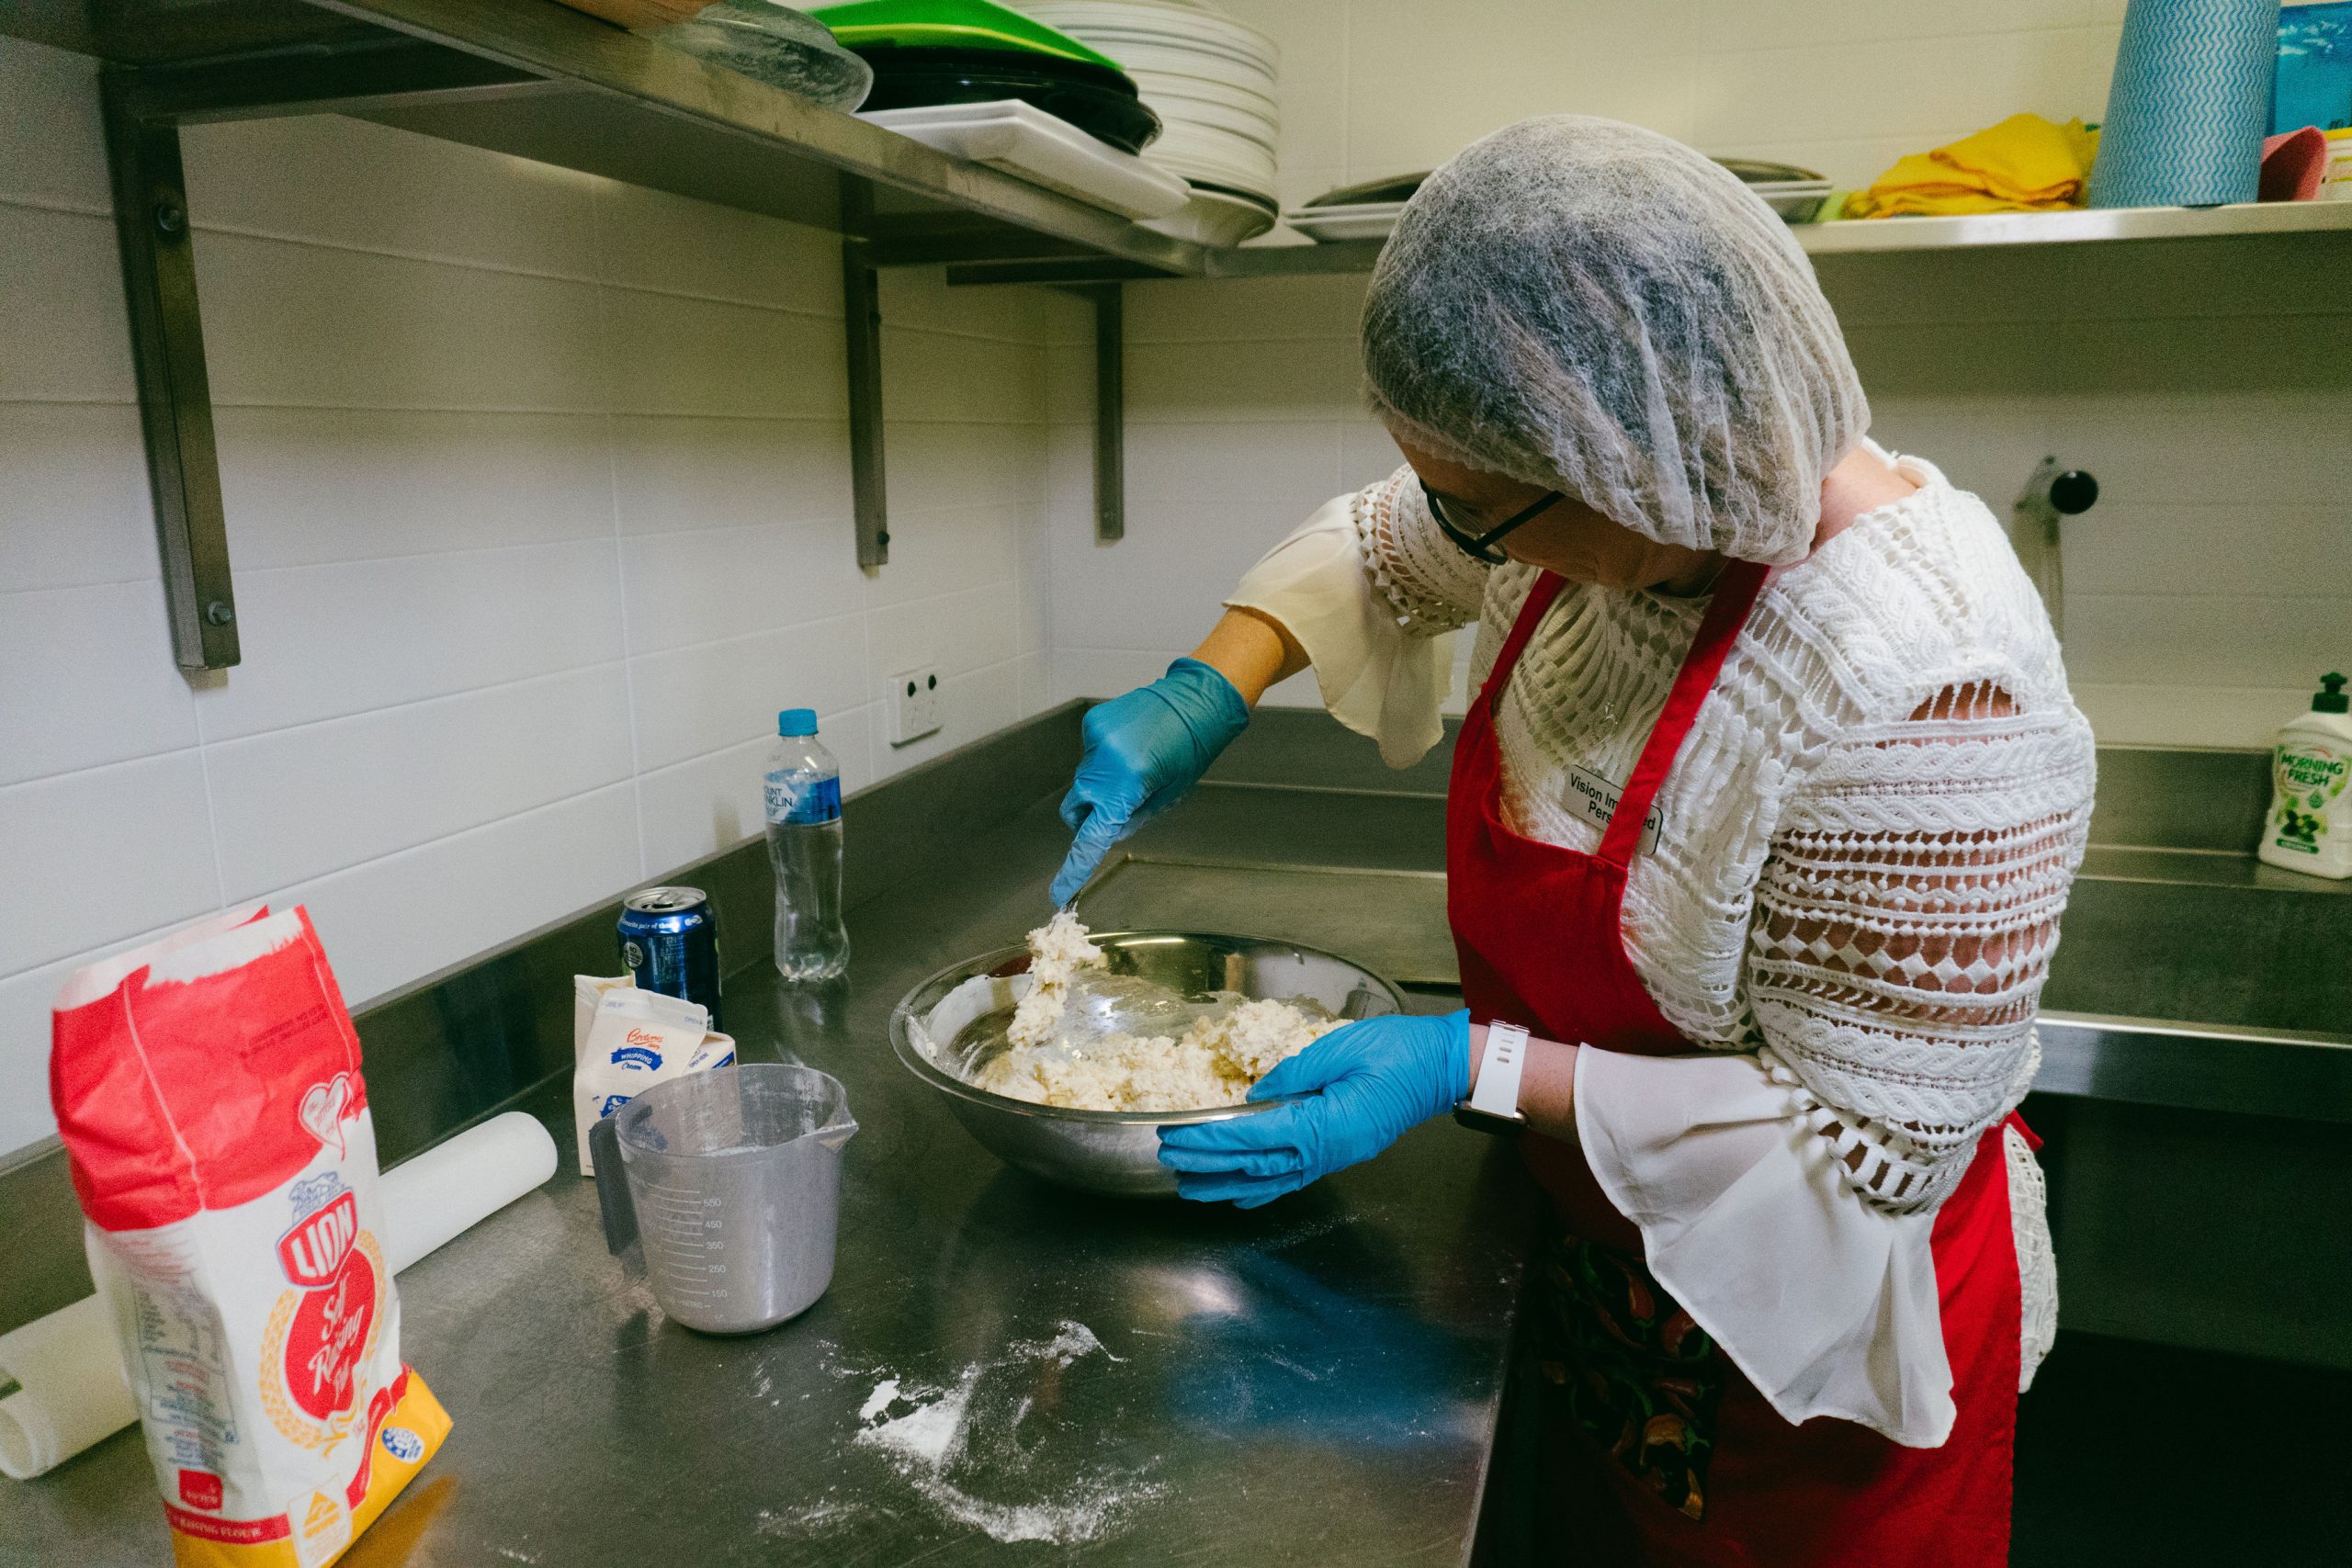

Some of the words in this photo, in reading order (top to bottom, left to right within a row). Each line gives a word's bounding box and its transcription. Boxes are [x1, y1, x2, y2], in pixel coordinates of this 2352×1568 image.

[2281, 754, 2343, 774] MORNING
[2287, 769, 2329, 786] FRESH
[764, 785, 782, 795] OUNT
[1570, 773, 1603, 803] Vision
[1588, 800, 1613, 825] Pers
[620, 1052, 653, 1065] WHIPPING
[621, 1061, 642, 1071] Cream
[703, 1199, 721, 1207] 550
[705, 1220, 722, 1229] 450
[290, 1199, 355, 1279] LION
[706, 1240, 724, 1250] 350
[710, 1288, 728, 1298] 150
